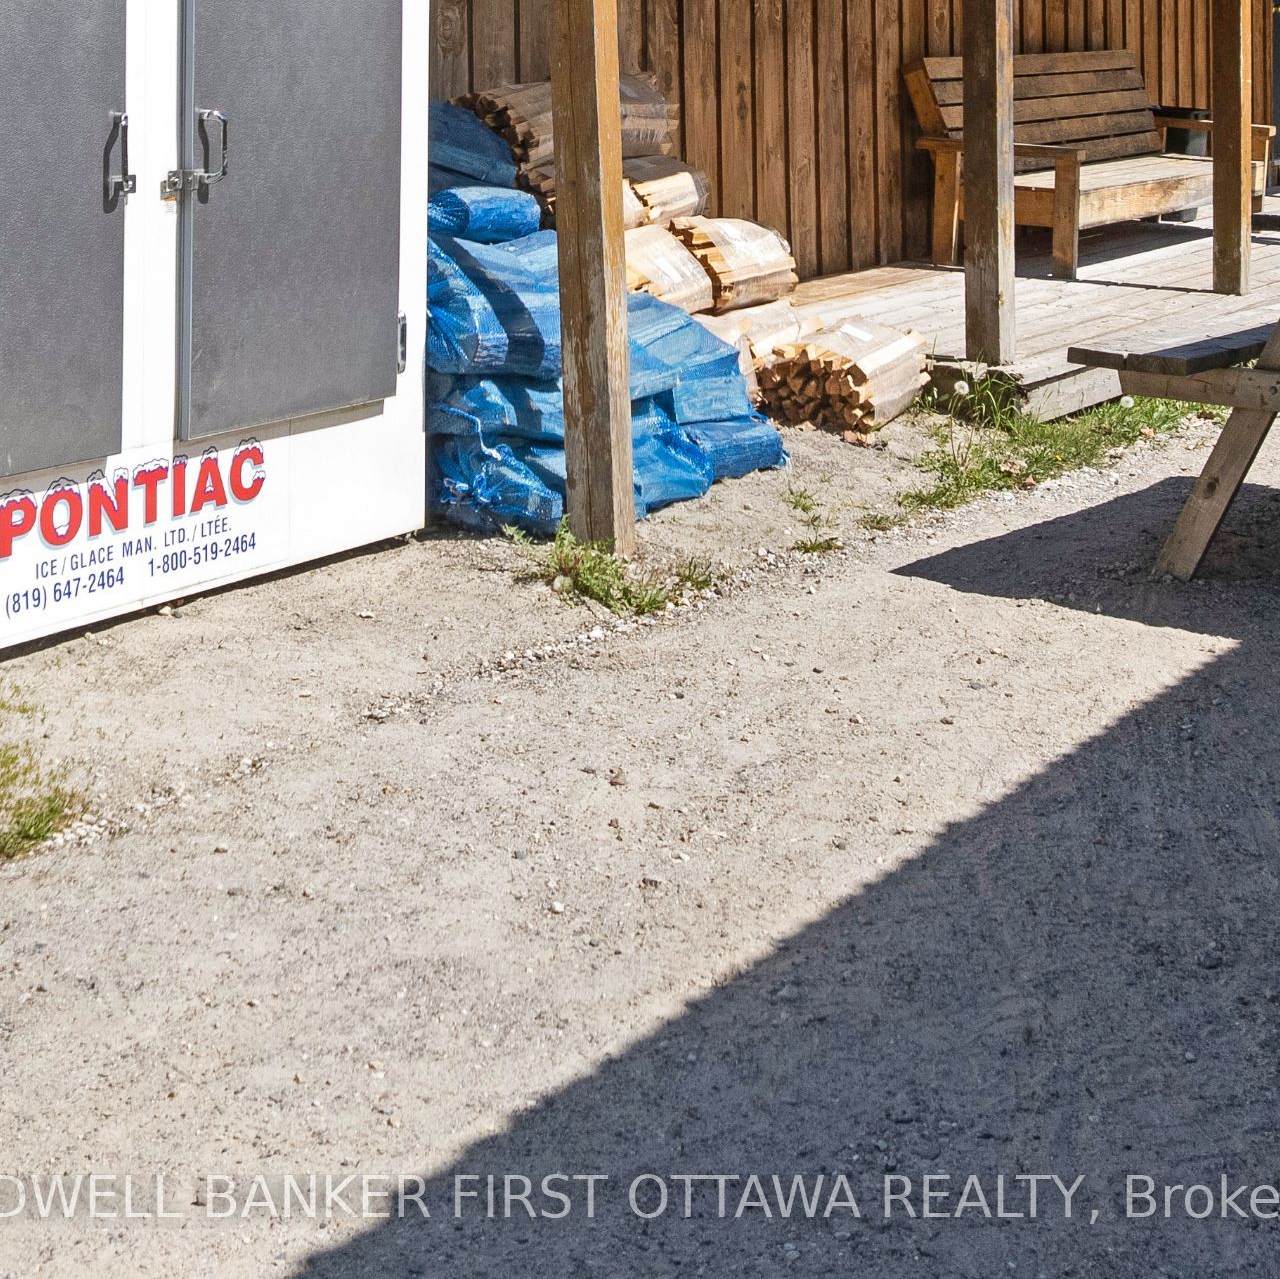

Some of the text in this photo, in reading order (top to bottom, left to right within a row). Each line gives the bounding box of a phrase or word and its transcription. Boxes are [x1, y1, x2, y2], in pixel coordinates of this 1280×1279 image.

[122, 535, 157, 559] MAN.
[5, 531, 257, 621] (819) 647-2464 1-800-519-2464
